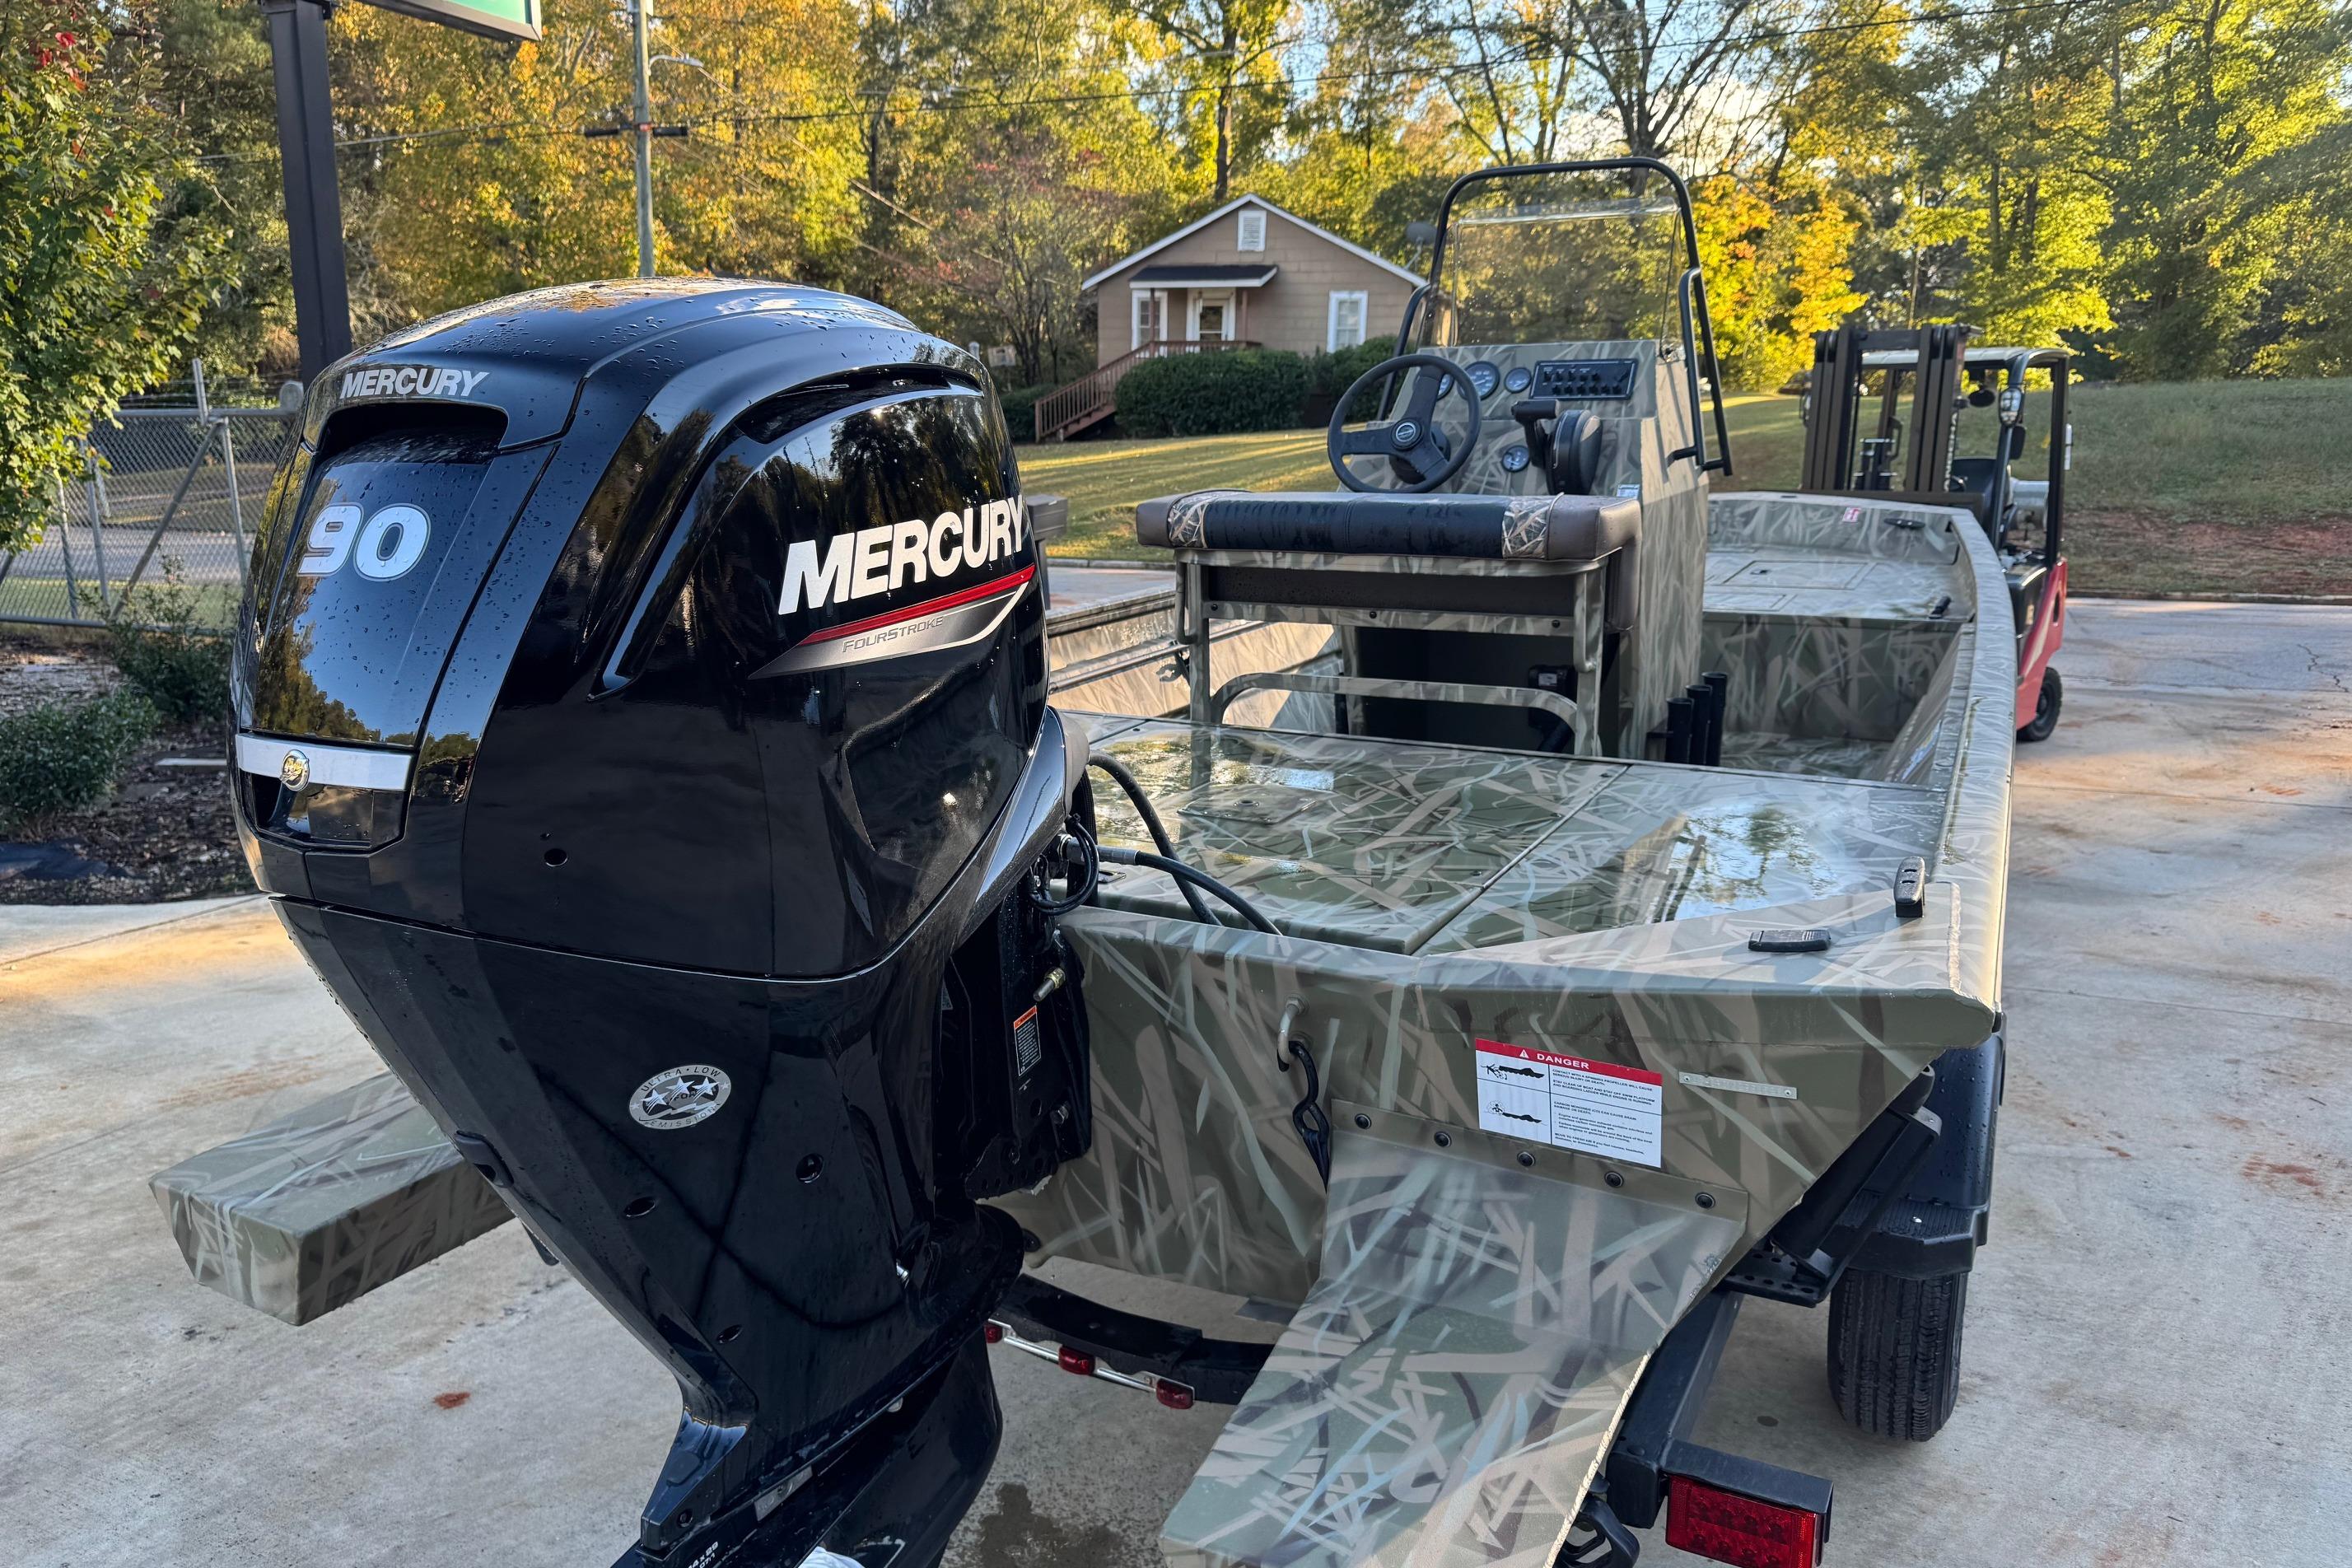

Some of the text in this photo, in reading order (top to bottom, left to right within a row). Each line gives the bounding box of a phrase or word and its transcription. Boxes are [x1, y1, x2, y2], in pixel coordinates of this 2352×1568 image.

[339, 367, 489, 399] MERCURY
[296, 502, 432, 582] 90
[778, 495, 1023, 615] MERCURY
[842, 616, 944, 653] FOURSTROKE
[1537, 1053, 1589, 1070] DANGER
[641, 1066, 721, 1092] ULTRA LOW
